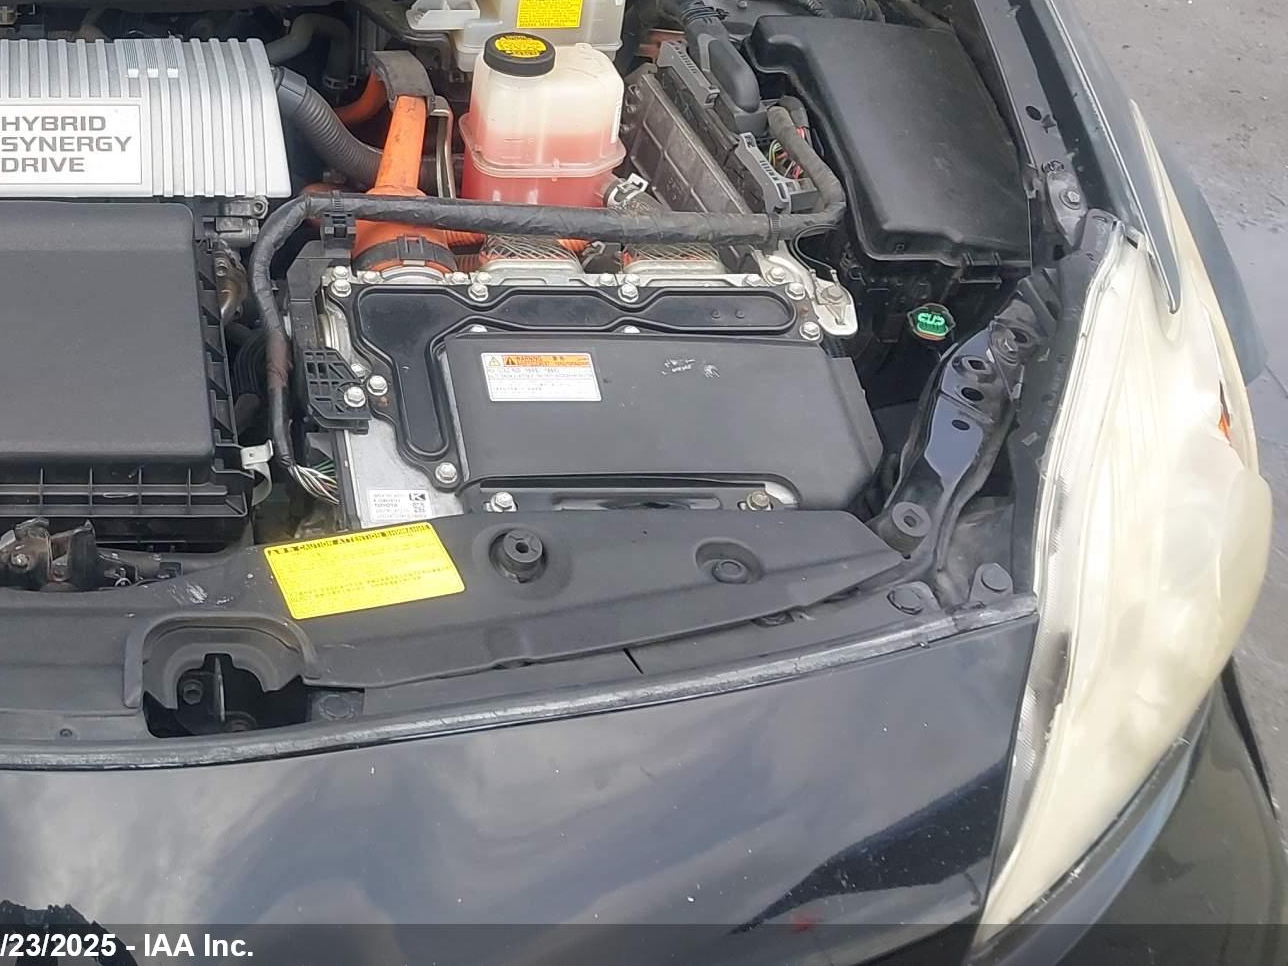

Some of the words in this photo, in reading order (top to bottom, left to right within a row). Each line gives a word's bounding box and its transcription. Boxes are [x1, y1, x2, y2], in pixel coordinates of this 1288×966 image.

[1, 116, 106, 132] HYBRID
[1, 137, 132, 152] SYNERGY
[1, 157, 85, 173] DRIVE
[298, 540, 334, 551] CAUTION
[338, 532, 382, 545] ATTENTION
